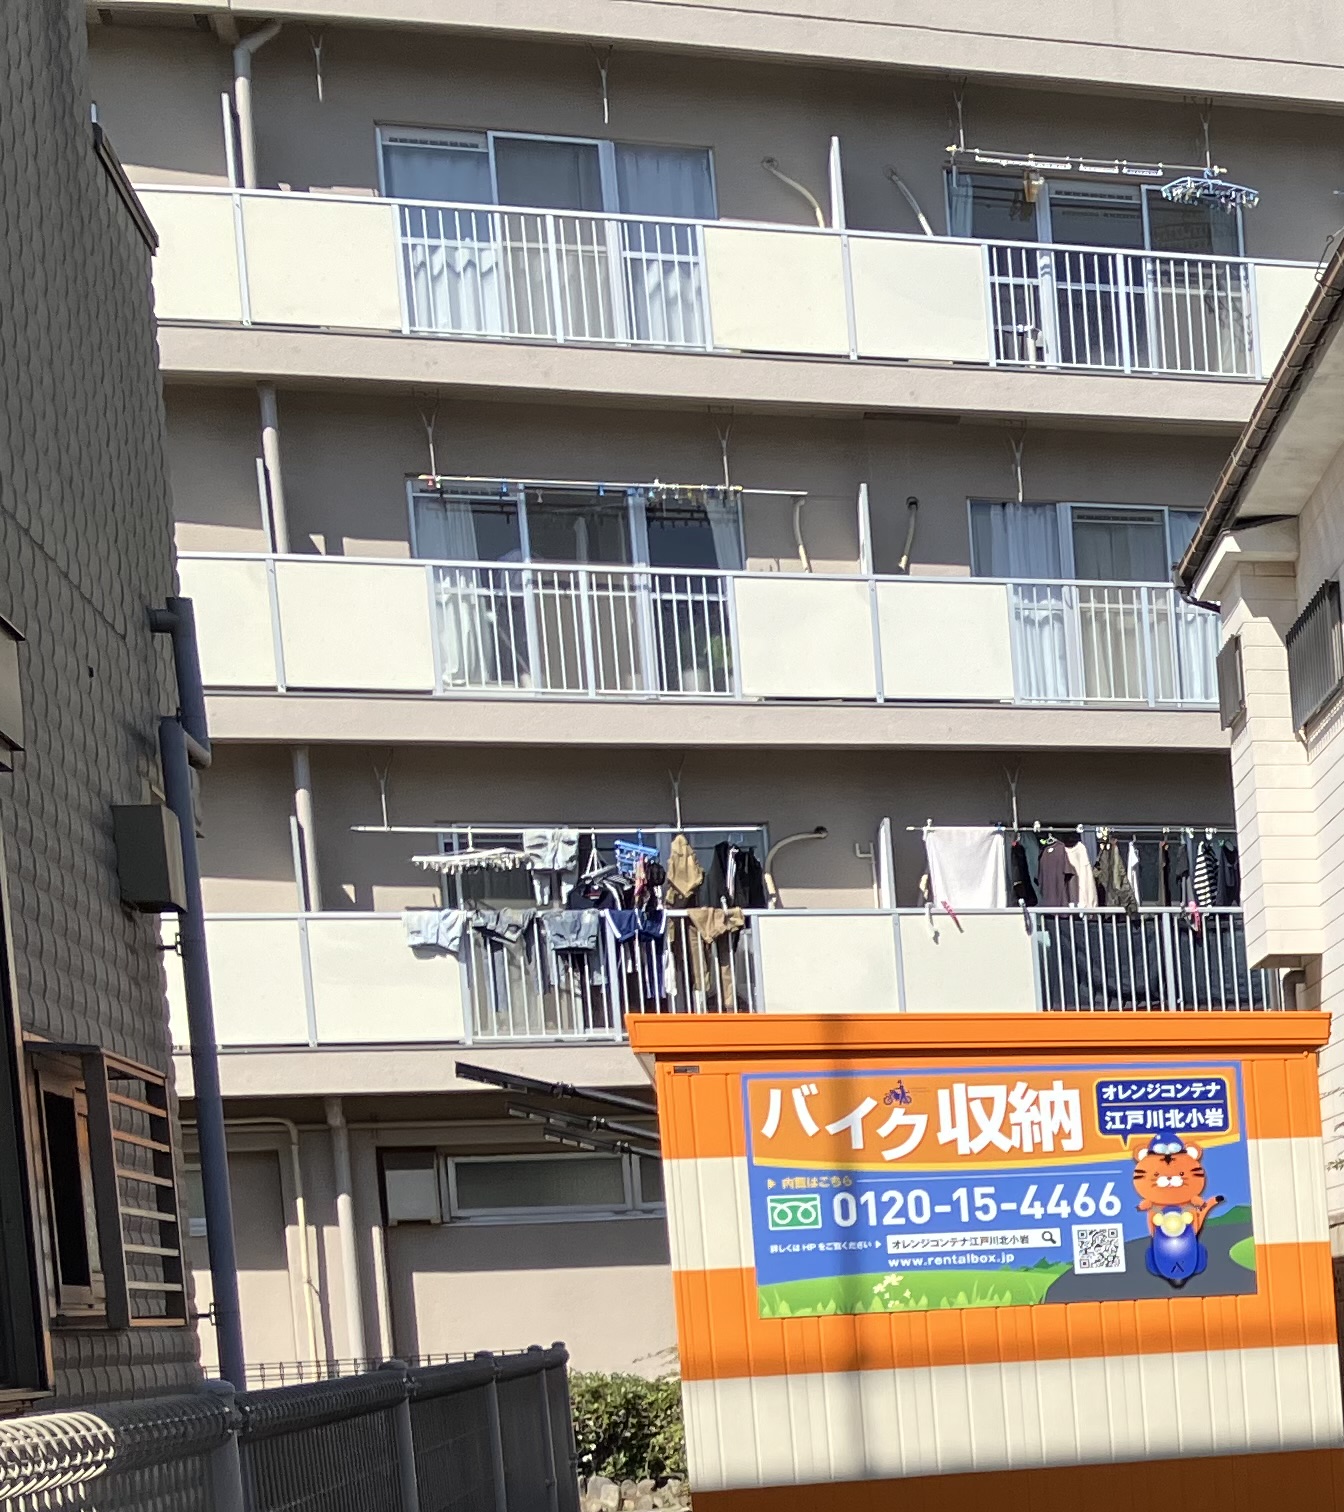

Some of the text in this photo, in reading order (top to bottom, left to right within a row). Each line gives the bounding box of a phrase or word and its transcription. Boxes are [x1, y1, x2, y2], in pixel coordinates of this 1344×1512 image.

[1101, 1082, 1221, 1100] オレンジコンテナ
[760, 1080, 1084, 1161] バイク収納
[1104, 1107, 1224, 1130] 江戸川北小岩
[832, 1181, 1122, 1228] 0120-15-4466
[892, 1234, 1030, 1250] オレンジコンテナ江戸川北小岩
[888, 1251, 1015, 1268] www.rentalbox.jp
